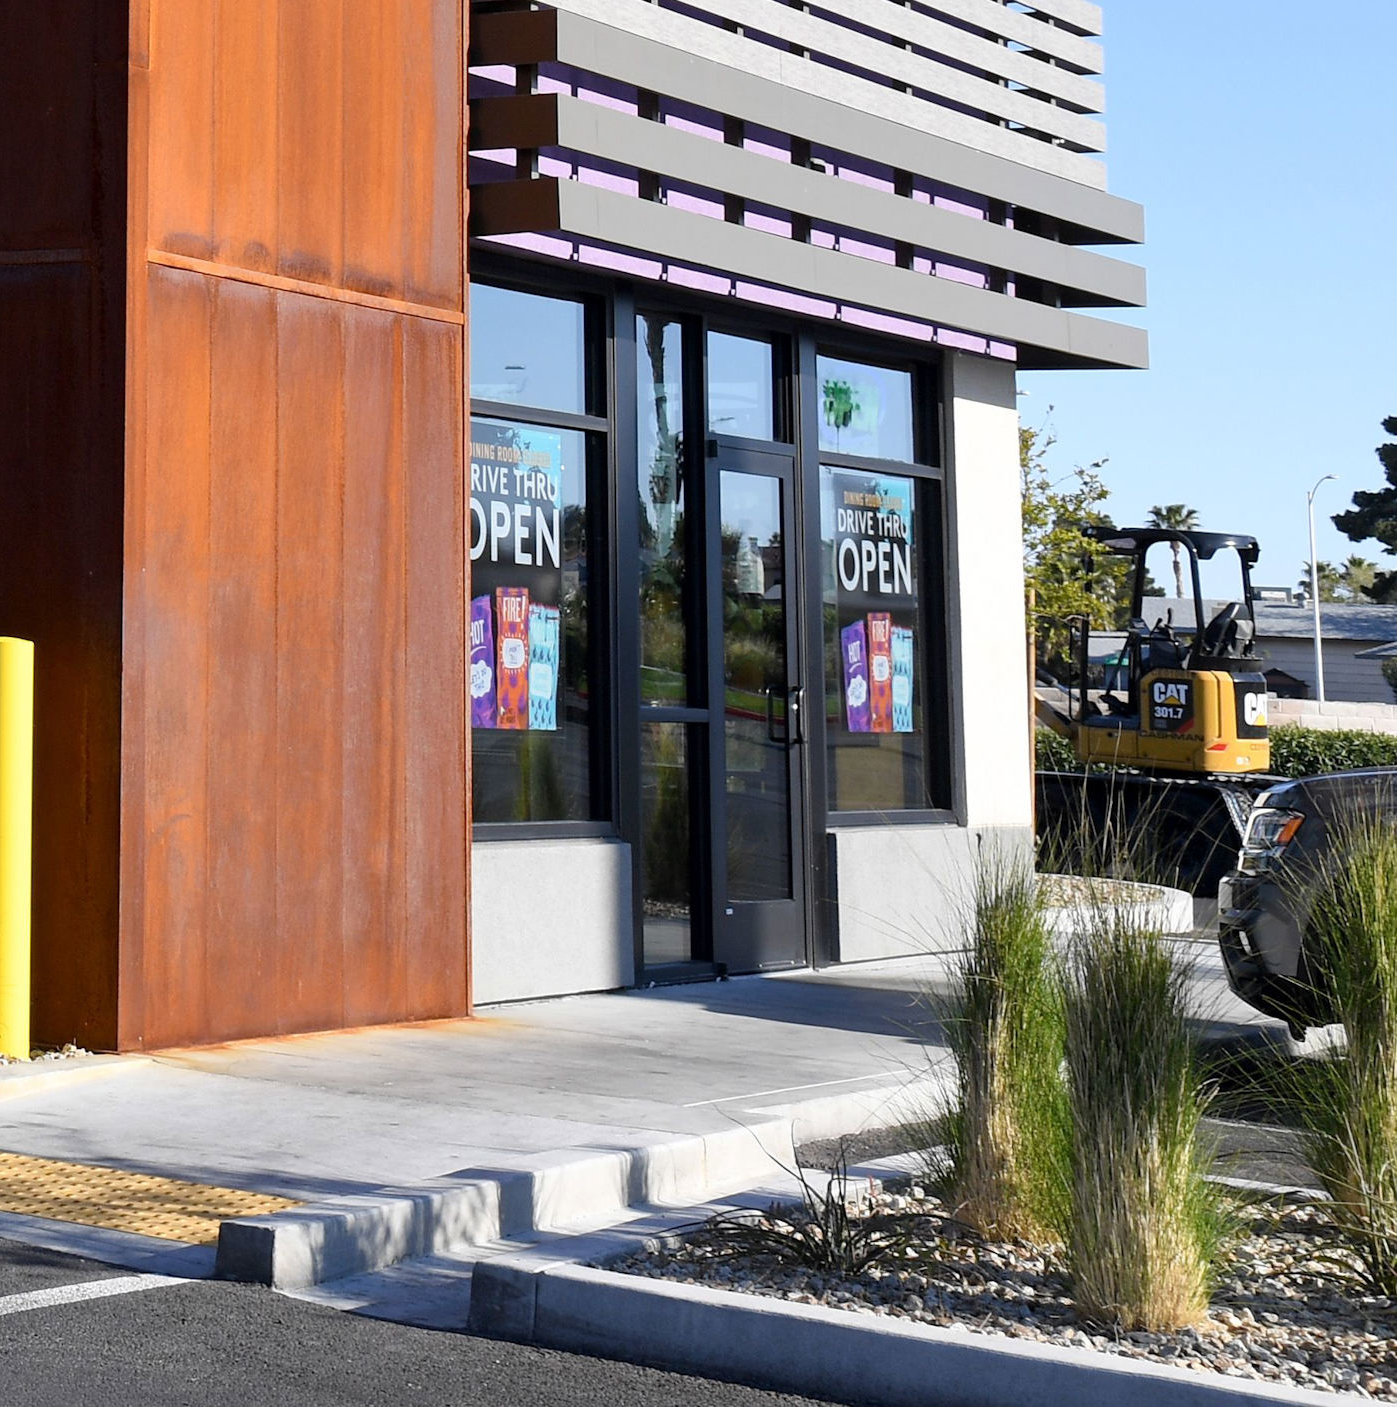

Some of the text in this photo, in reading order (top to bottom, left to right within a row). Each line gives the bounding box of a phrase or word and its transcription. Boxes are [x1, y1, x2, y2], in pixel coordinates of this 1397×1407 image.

[471, 463, 558, 502] RIVE THRU
[837, 508, 909, 539] DRIVE THRU
[838, 538, 912, 595] OPEN
[502, 595, 526, 629] FIRE!
[1153, 682, 1188, 705] CAT
[1244, 692, 1268, 725] CA
[1154, 706, 1183, 719] 301.7
